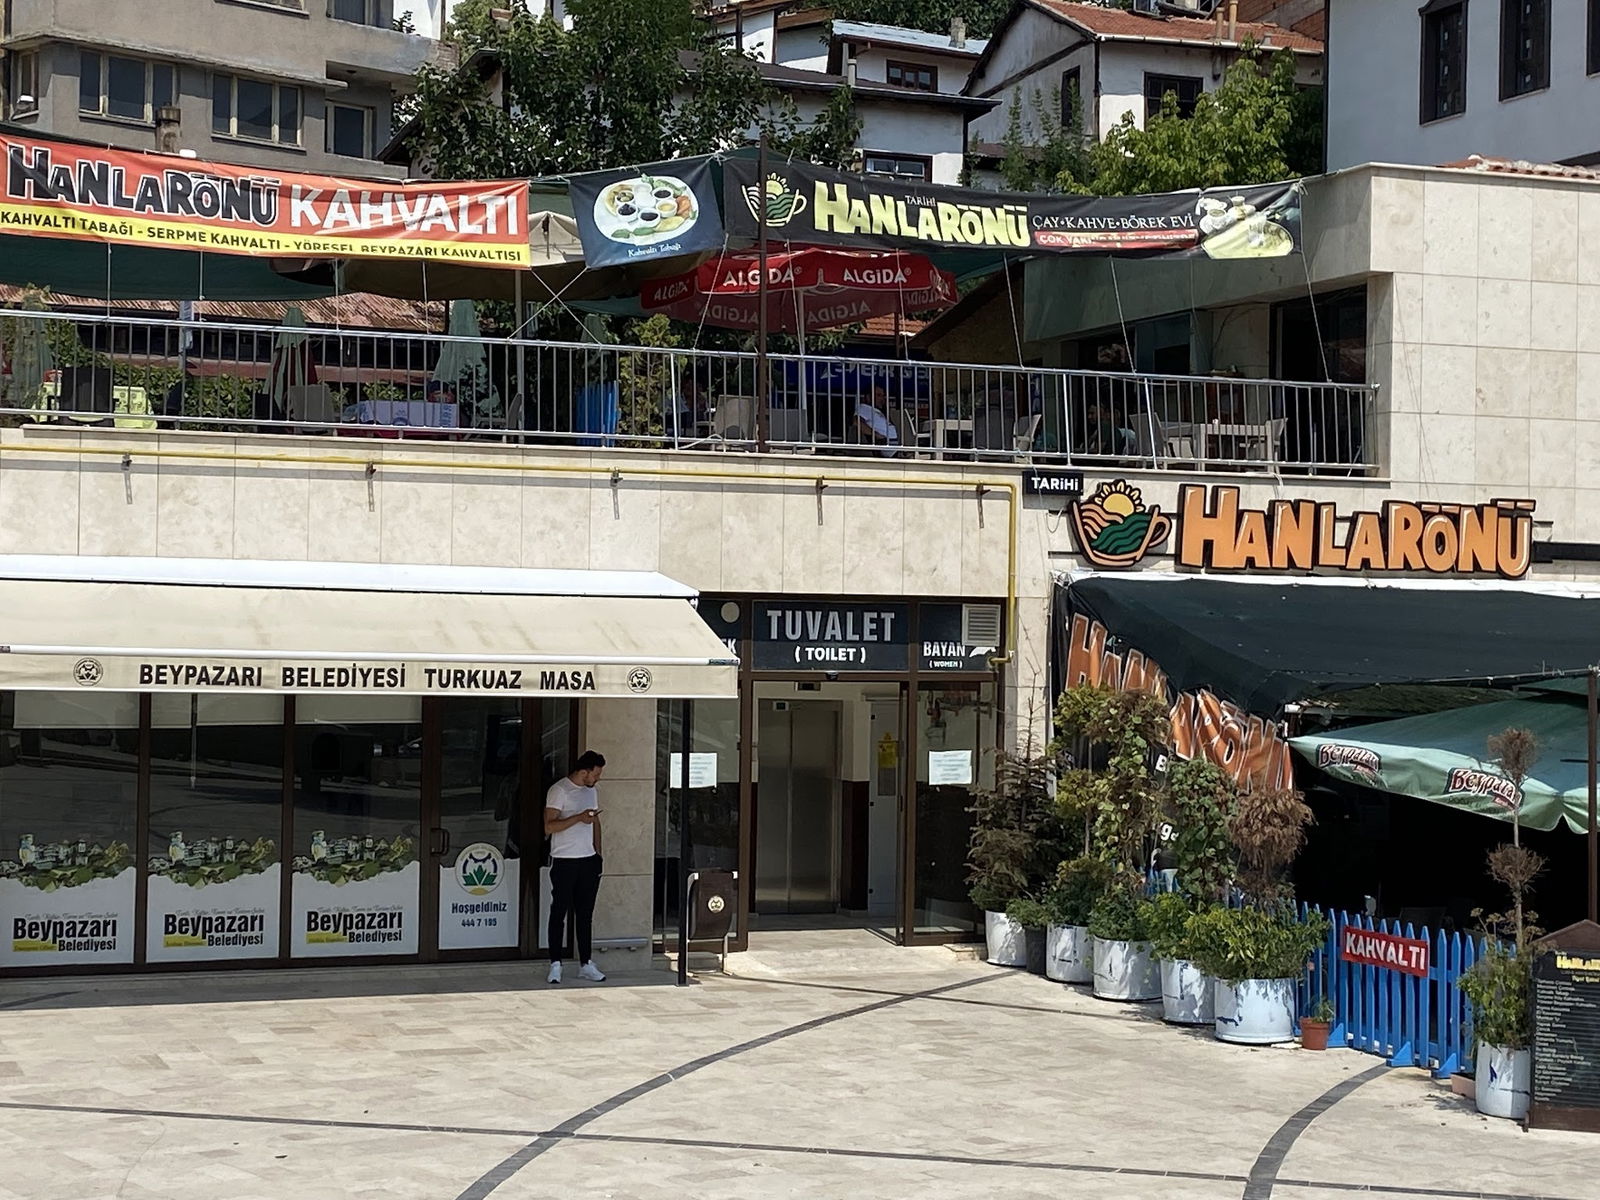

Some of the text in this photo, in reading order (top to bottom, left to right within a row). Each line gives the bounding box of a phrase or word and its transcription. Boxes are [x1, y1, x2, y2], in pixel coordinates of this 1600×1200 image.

[291, 184, 520, 236] KAHVALTI
[814, 180, 1031, 247] HANLARÖNÜ
[1, 211, 76, 229] KAHVALTI
[79, 217, 133, 236] TABAĞI
[147, 226, 207, 243] SERPME
[210, 230, 281, 250] KAHVALTI
[441, 247, 521, 262] KAHVALTISI
[1178, 483, 1536, 579] HANLARÖNÜ
[767, 609, 895, 642] TUVALET
[923, 641, 966, 657] BAYAN
[139, 663, 596, 691] BEYPAZARI BELEDİYESİ TURKUAZ MASA
[13, 917, 117, 944] Beypazarı
[164, 914, 264, 939] Beypazarı
[307, 911, 403, 936] Beypazarı
[58, 937, 117, 952] Belediyesi
[207, 933, 264, 947] Belediyesi
[348, 931, 402, 944] Belediyesi
[1346, 932, 1426, 970] KAHVALTI
